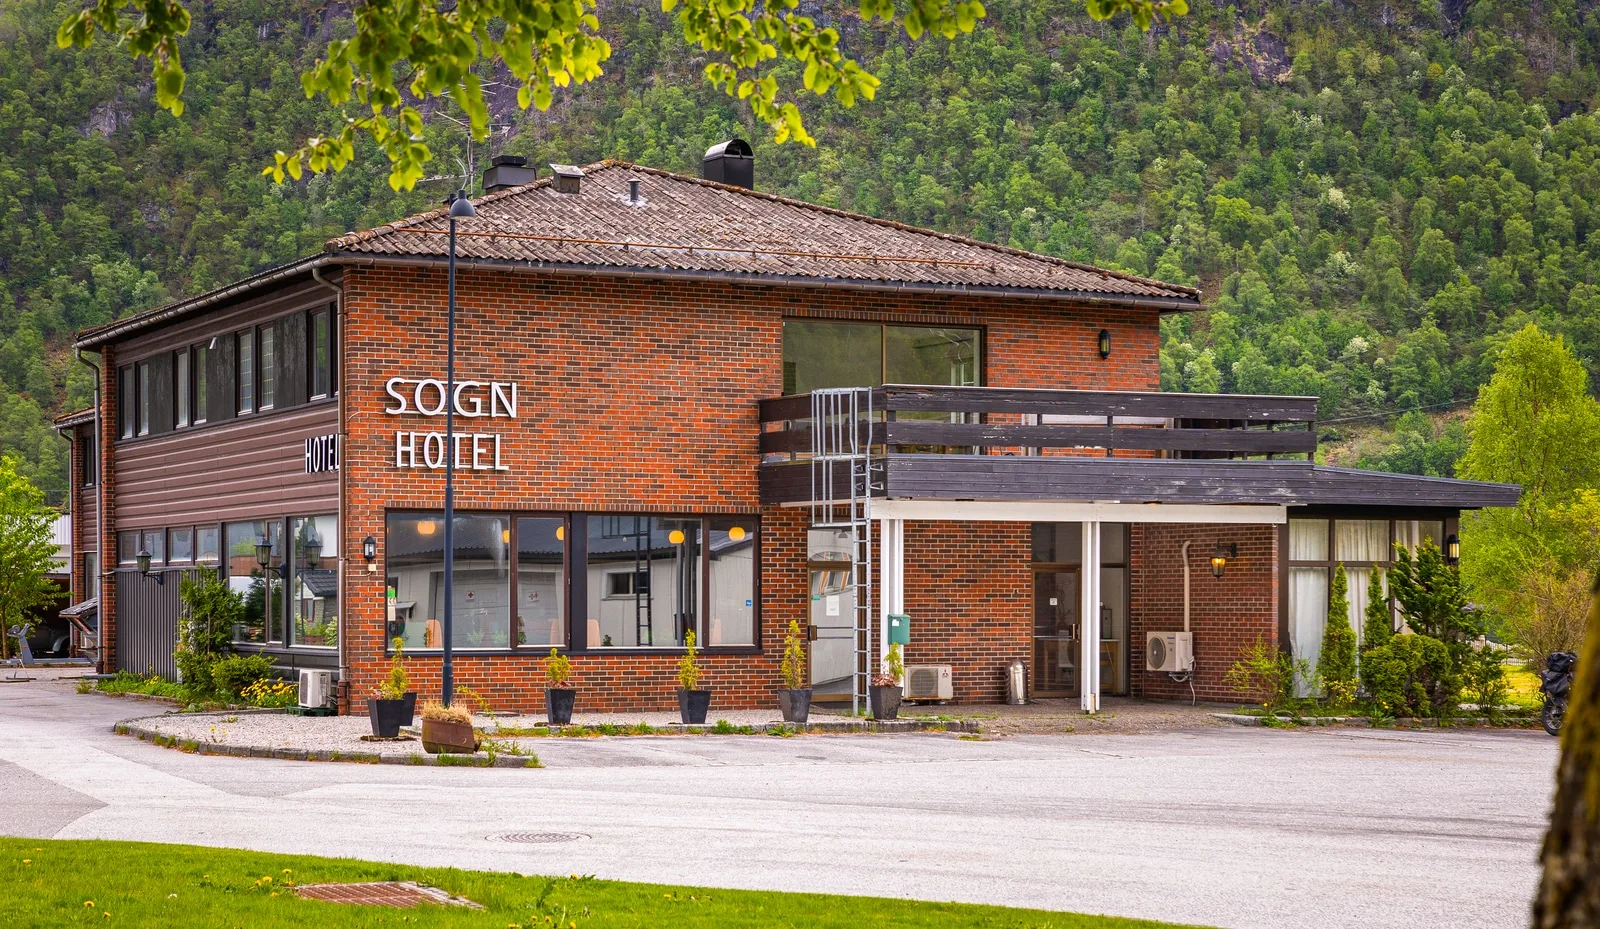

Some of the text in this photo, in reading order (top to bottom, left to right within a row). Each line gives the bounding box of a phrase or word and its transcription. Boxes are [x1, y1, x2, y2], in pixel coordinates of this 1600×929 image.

[385, 377, 517, 418] SOGN
[305, 433, 340, 473] HOTEL
[396, 431, 509, 471] HOTEL
